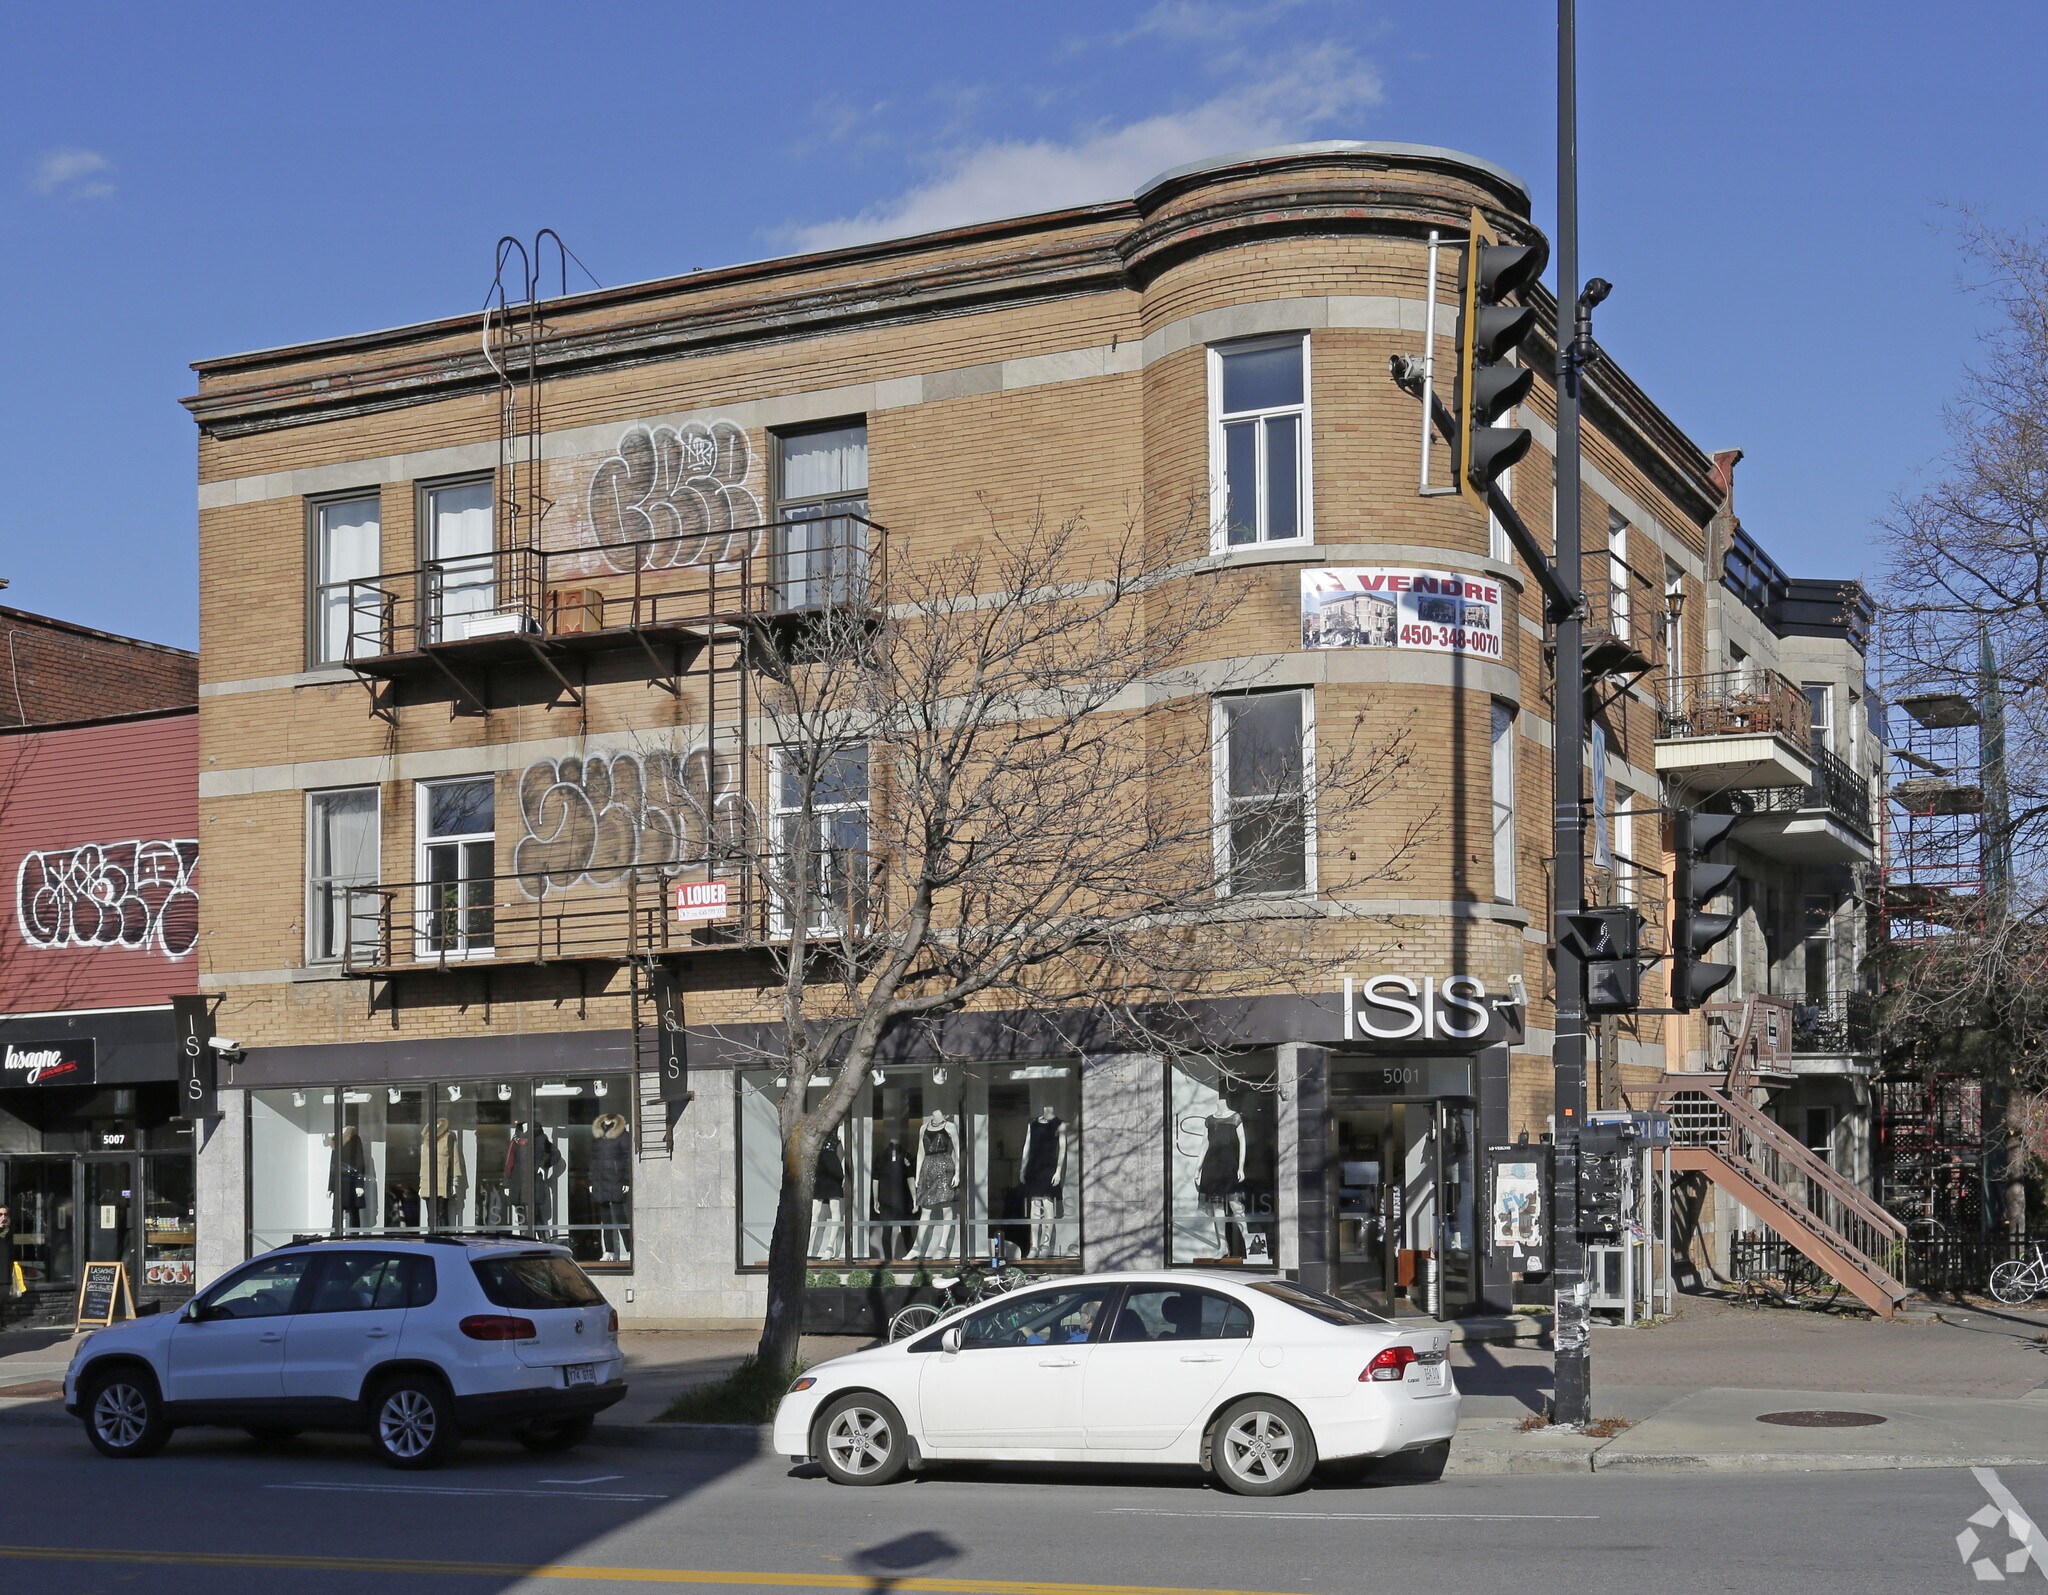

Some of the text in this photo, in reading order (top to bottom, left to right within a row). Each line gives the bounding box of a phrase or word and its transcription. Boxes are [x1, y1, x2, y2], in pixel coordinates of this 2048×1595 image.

[1357, 575, 1498, 604] VENDRE
[1400, 624, 1499, 656] 450-348-0070
[686, 884, 727, 906] LOUER
[1343, 974, 1490, 1040] ISIS
[665, 986, 680, 1079] ISIS
[4, 1044, 62, 1085] lasagne
[186, 1014, 203, 1100] ISIS
[1383, 1068, 1419, 1084] 5001
[103, 1134, 125, 1145] 5007
